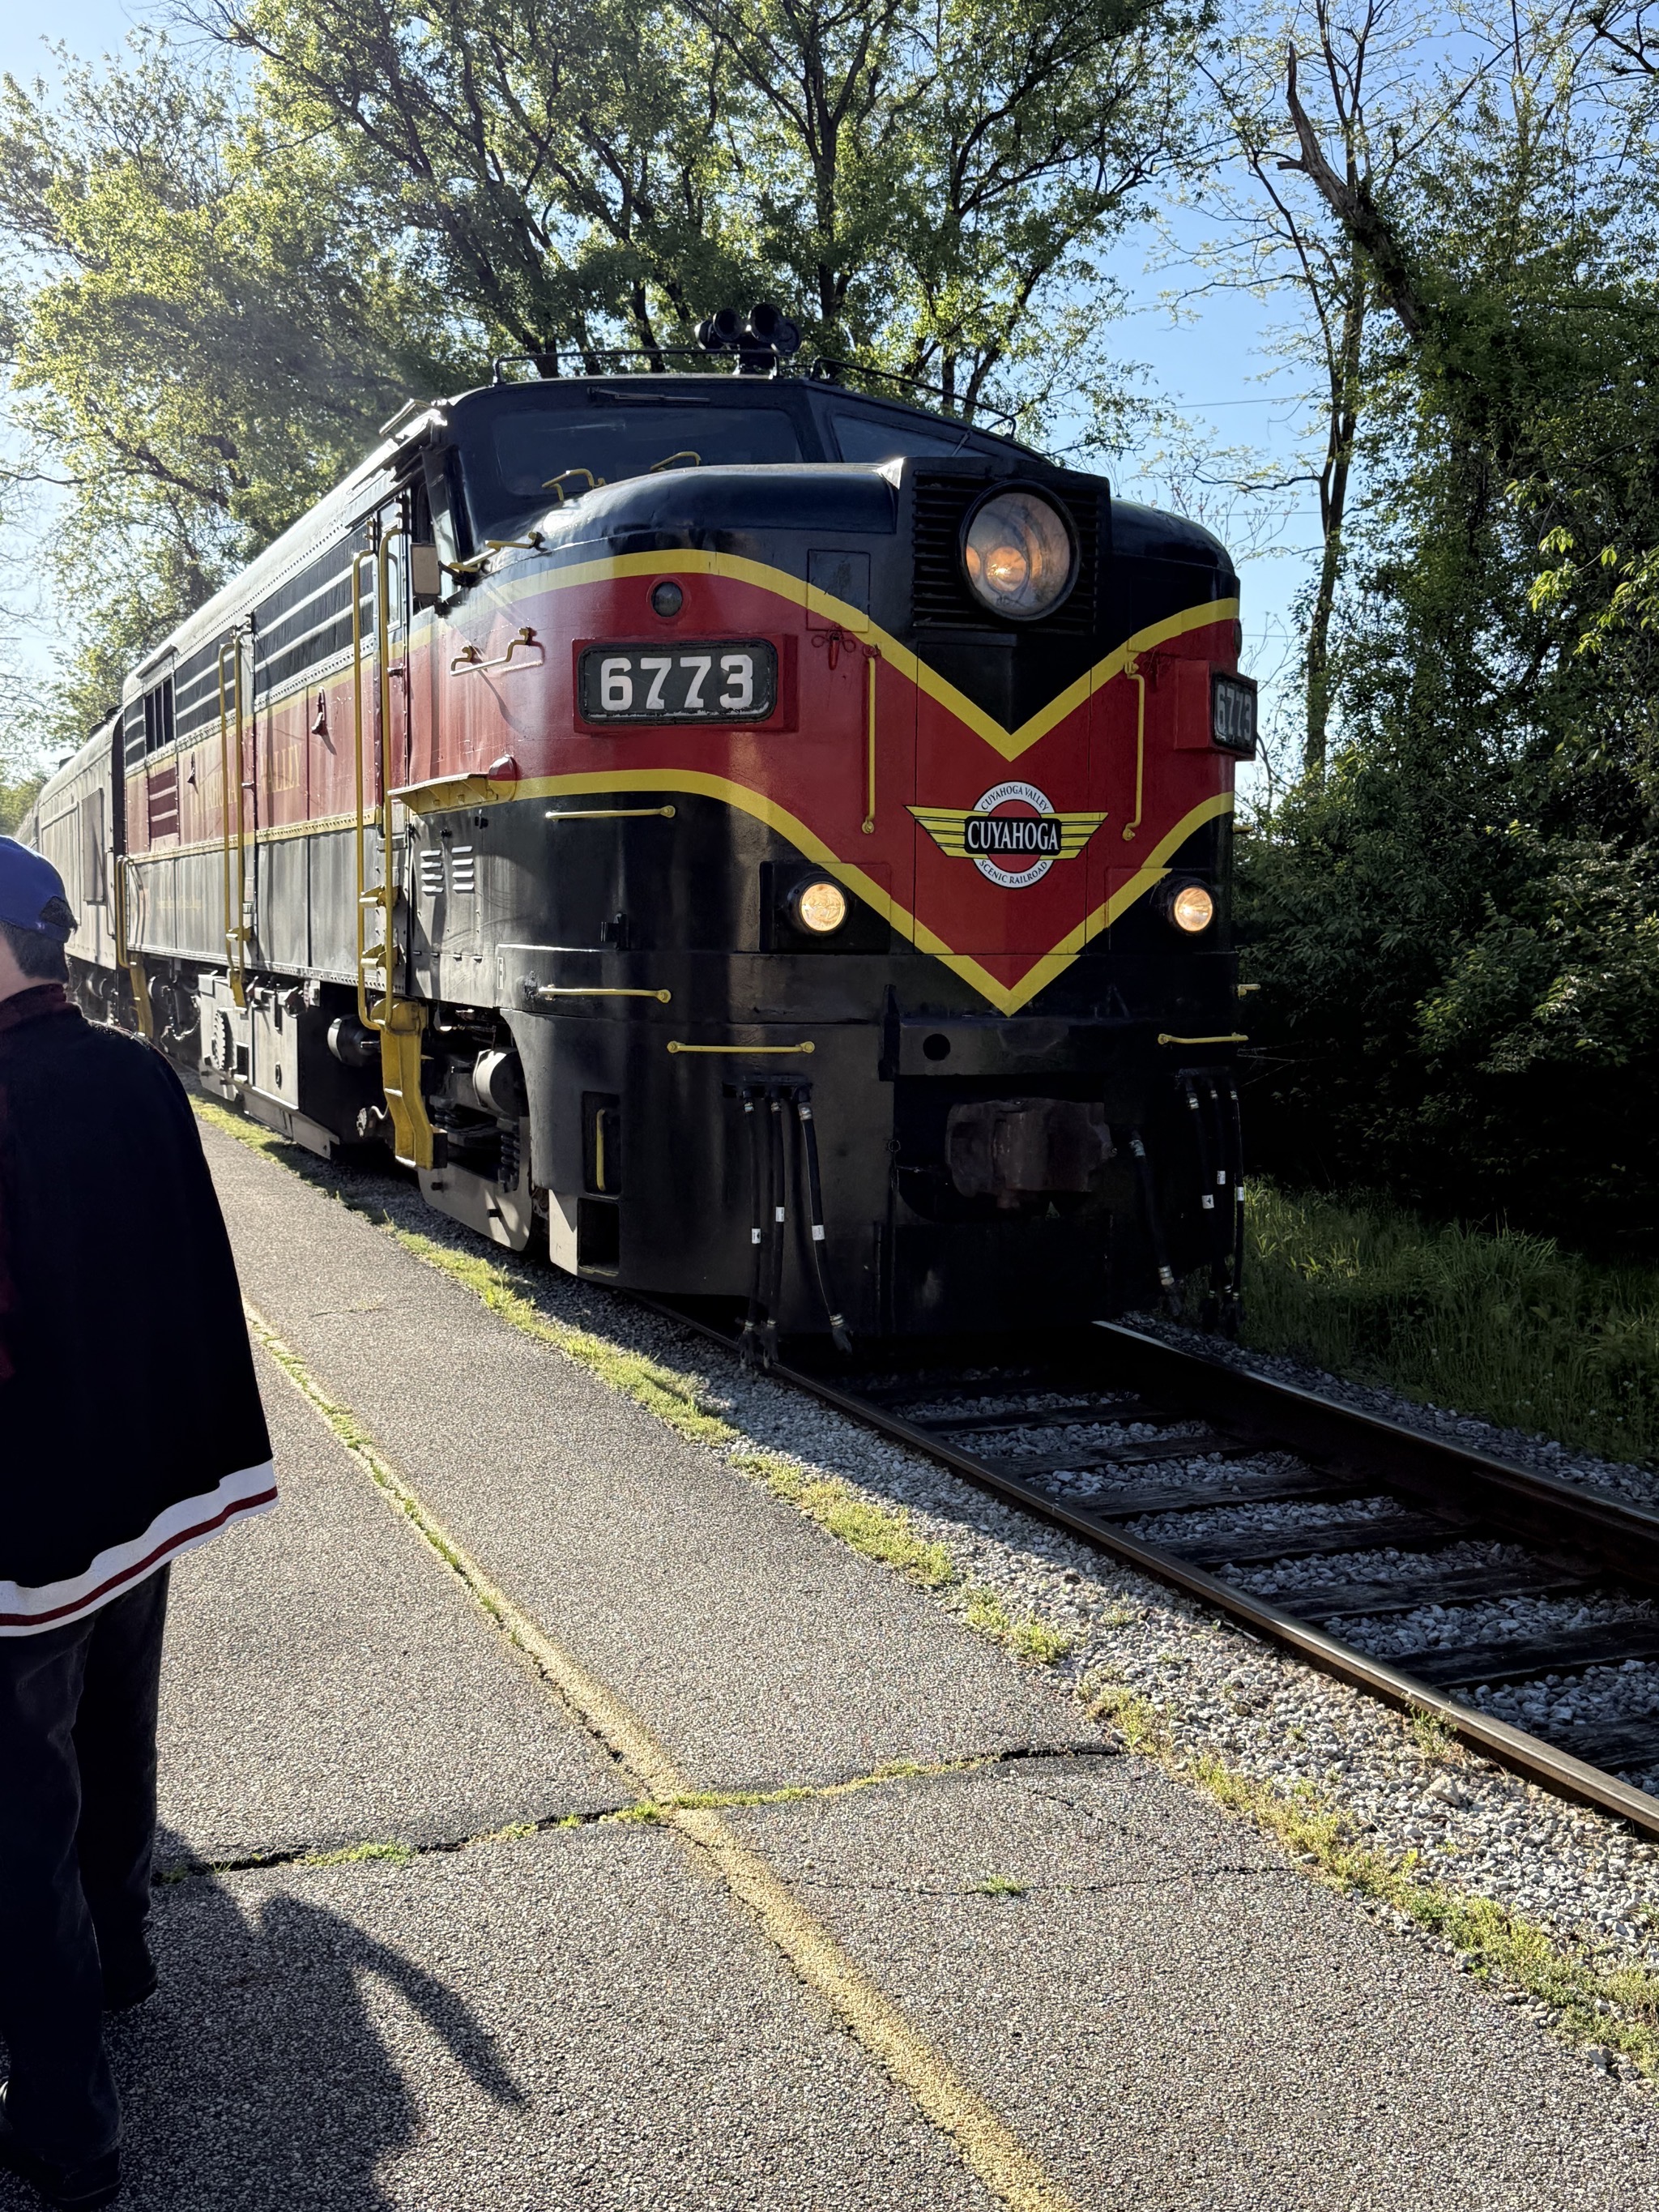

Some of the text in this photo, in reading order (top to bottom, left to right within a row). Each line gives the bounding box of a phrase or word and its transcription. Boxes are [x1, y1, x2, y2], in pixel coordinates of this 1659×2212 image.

[601, 655, 753, 711] 6773
[1217, 684, 1252, 741] 6773
[981, 785, 1049, 811] CUYAHOGA VALLEY
[967, 820, 1060, 851] CUYAHOGA
[979, 860, 1047, 884] SCENIC RAILROAD
